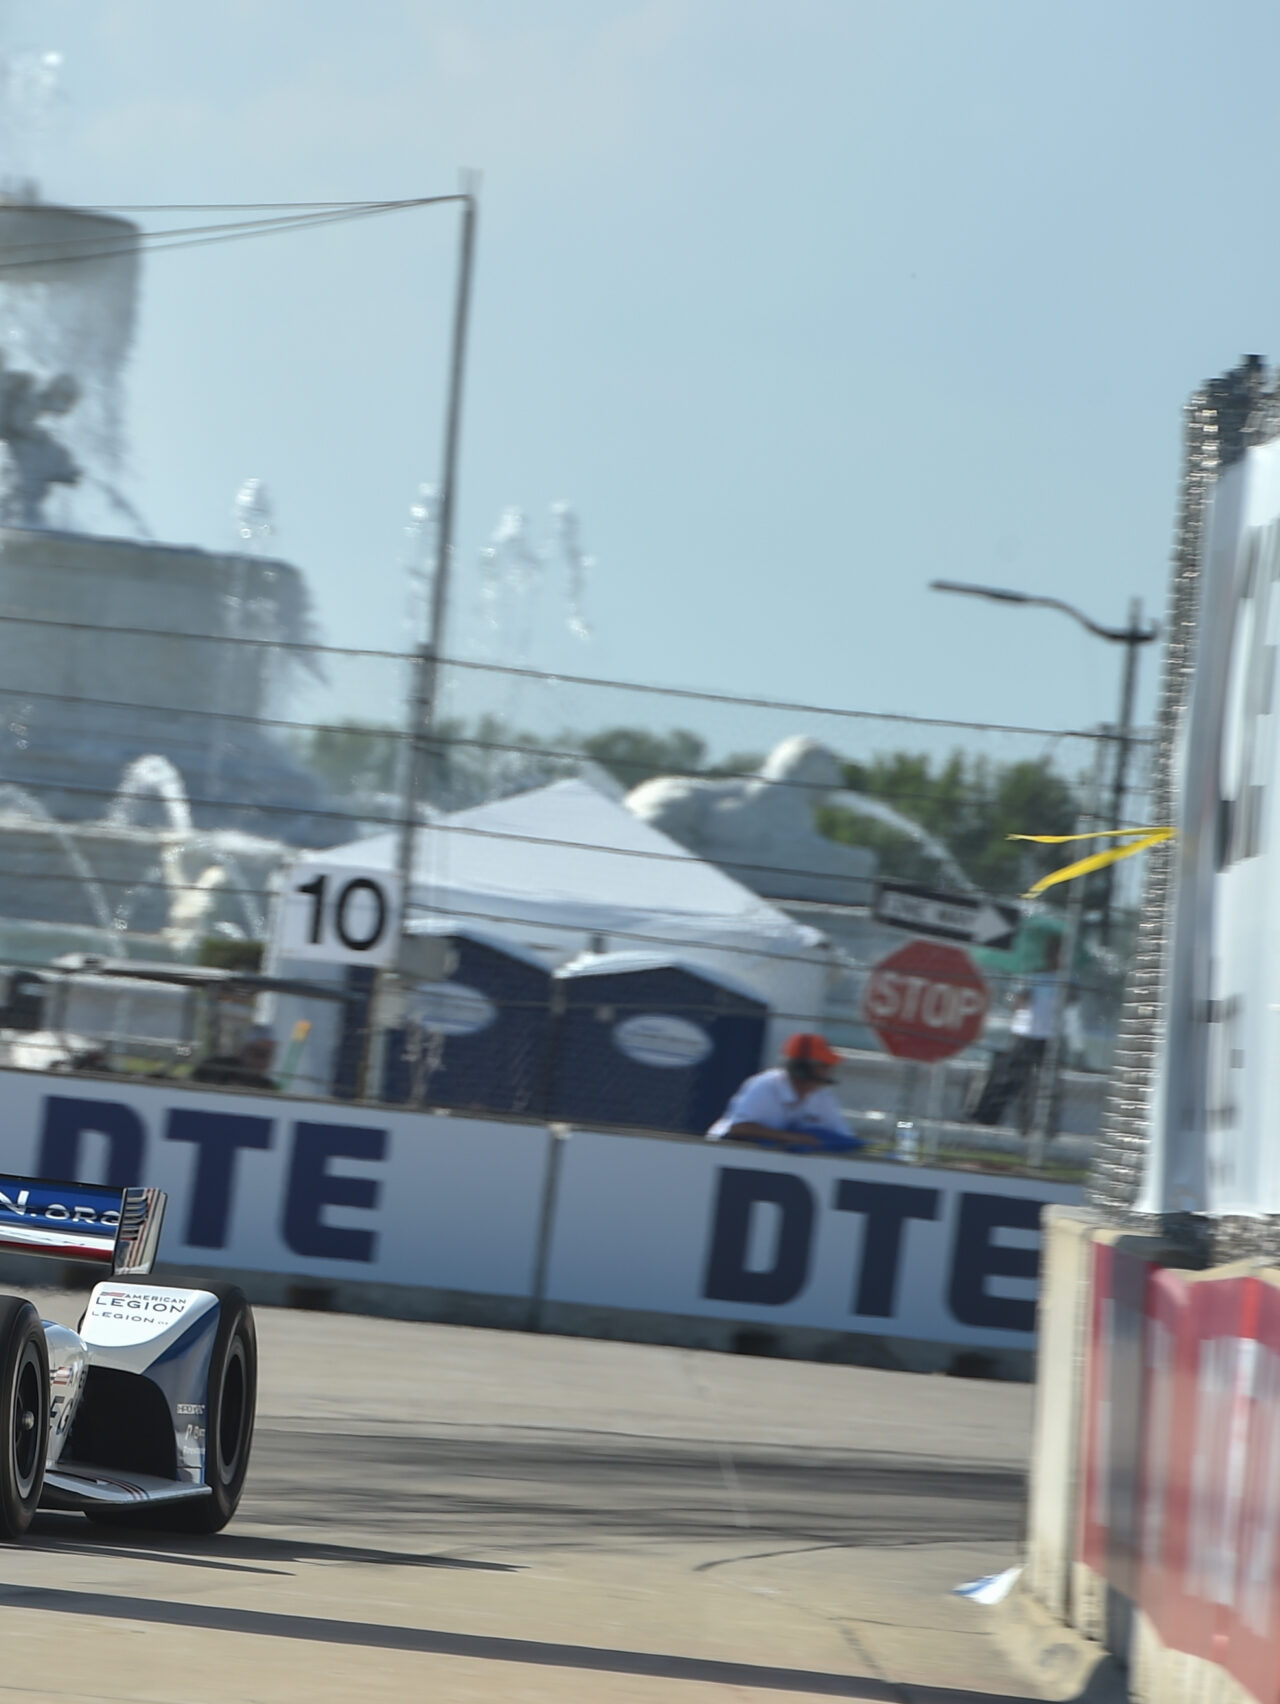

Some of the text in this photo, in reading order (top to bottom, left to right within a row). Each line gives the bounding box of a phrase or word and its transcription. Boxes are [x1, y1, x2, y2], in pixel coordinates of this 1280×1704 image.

[295, 873, 387, 952] 10
[869, 971, 984, 1030] STOP
[35, 1094, 391, 1263] DTE
[701, 1166, 1047, 1332] DTE
[95, 1296, 185, 1313] LEGION
[124, 1293, 187, 1305] AMERICAN
